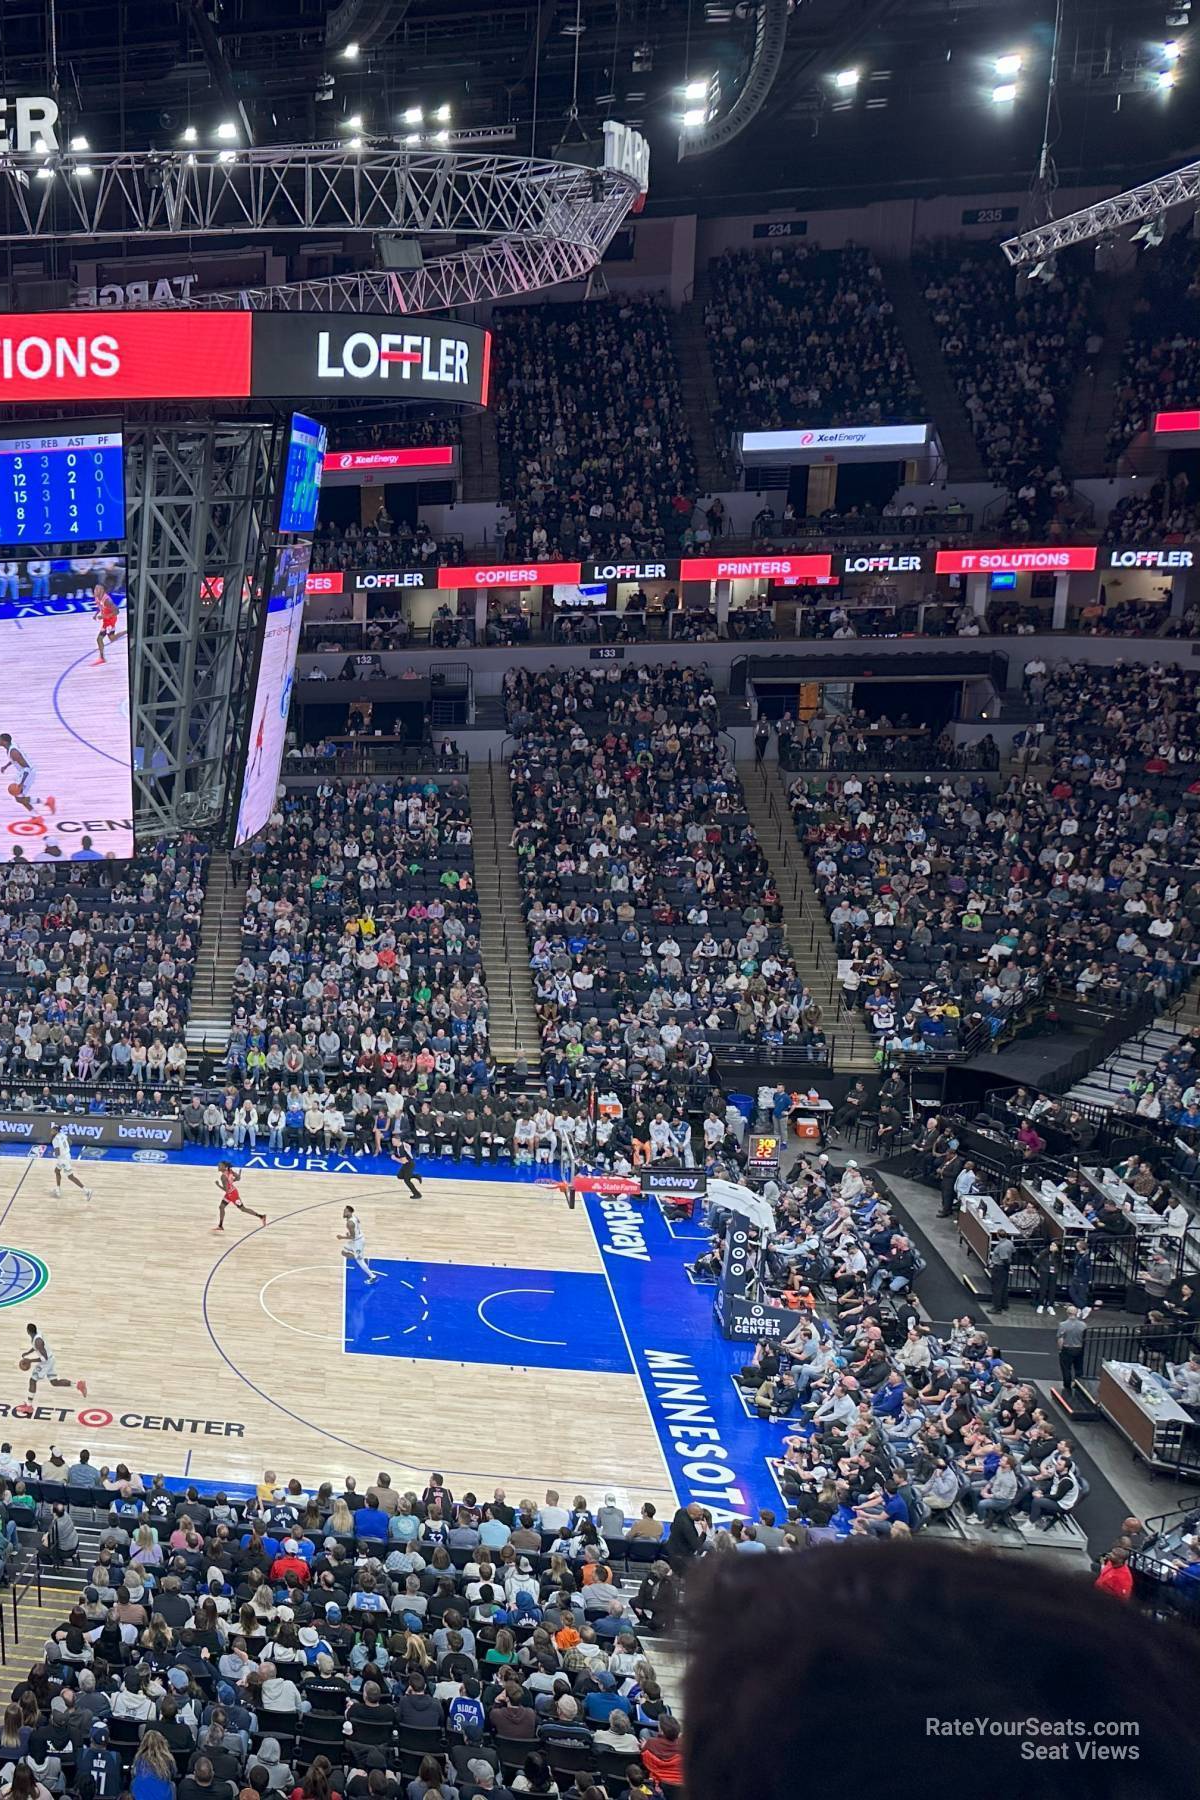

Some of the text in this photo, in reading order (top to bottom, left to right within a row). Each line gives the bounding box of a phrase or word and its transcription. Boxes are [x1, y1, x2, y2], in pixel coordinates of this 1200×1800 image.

[977, 210, 1001, 223] 235
[768, 224, 792, 236] 234
[317, 331, 470, 386] LOFFLER
[14, 436, 110, 450] PTS REB AST PF
[14, 457, 23, 470] 3
[41, 455, 49, 468] 3
[67, 454, 77, 467] 0
[13, 474, 26, 487] 12
[67, 471, 77, 483] 2
[14, 491, 27, 503] 15
[17, 504, 78, 520] 8 3
[17, 521, 79, 537] 7 4
[844, 555, 922, 574] LOFFLER
[961, 550, 1071, 569] IT SOLUTIONS
[1109, 550, 1194, 569] LOFFLER
[474, 569, 538, 584] COPIERS
[593, 562, 667, 581] LOFFLER
[717, 560, 792, 577] PRINTERS
[355, 571, 425, 590] LOFFLER
[355, 655, 373, 666] 132
[598, 648, 616, 659] 133
[118, 1124, 173, 1142] betway
[650, 1175, 699, 1190] betway
[734, 1316, 781, 1328] TARGET
[734, 1325, 781, 1336] CENTER
[120, 1413, 246, 1438] CENTER
[644, 1349, 753, 1525] MINNESOTA
[428, 1533, 444, 1543] 32
